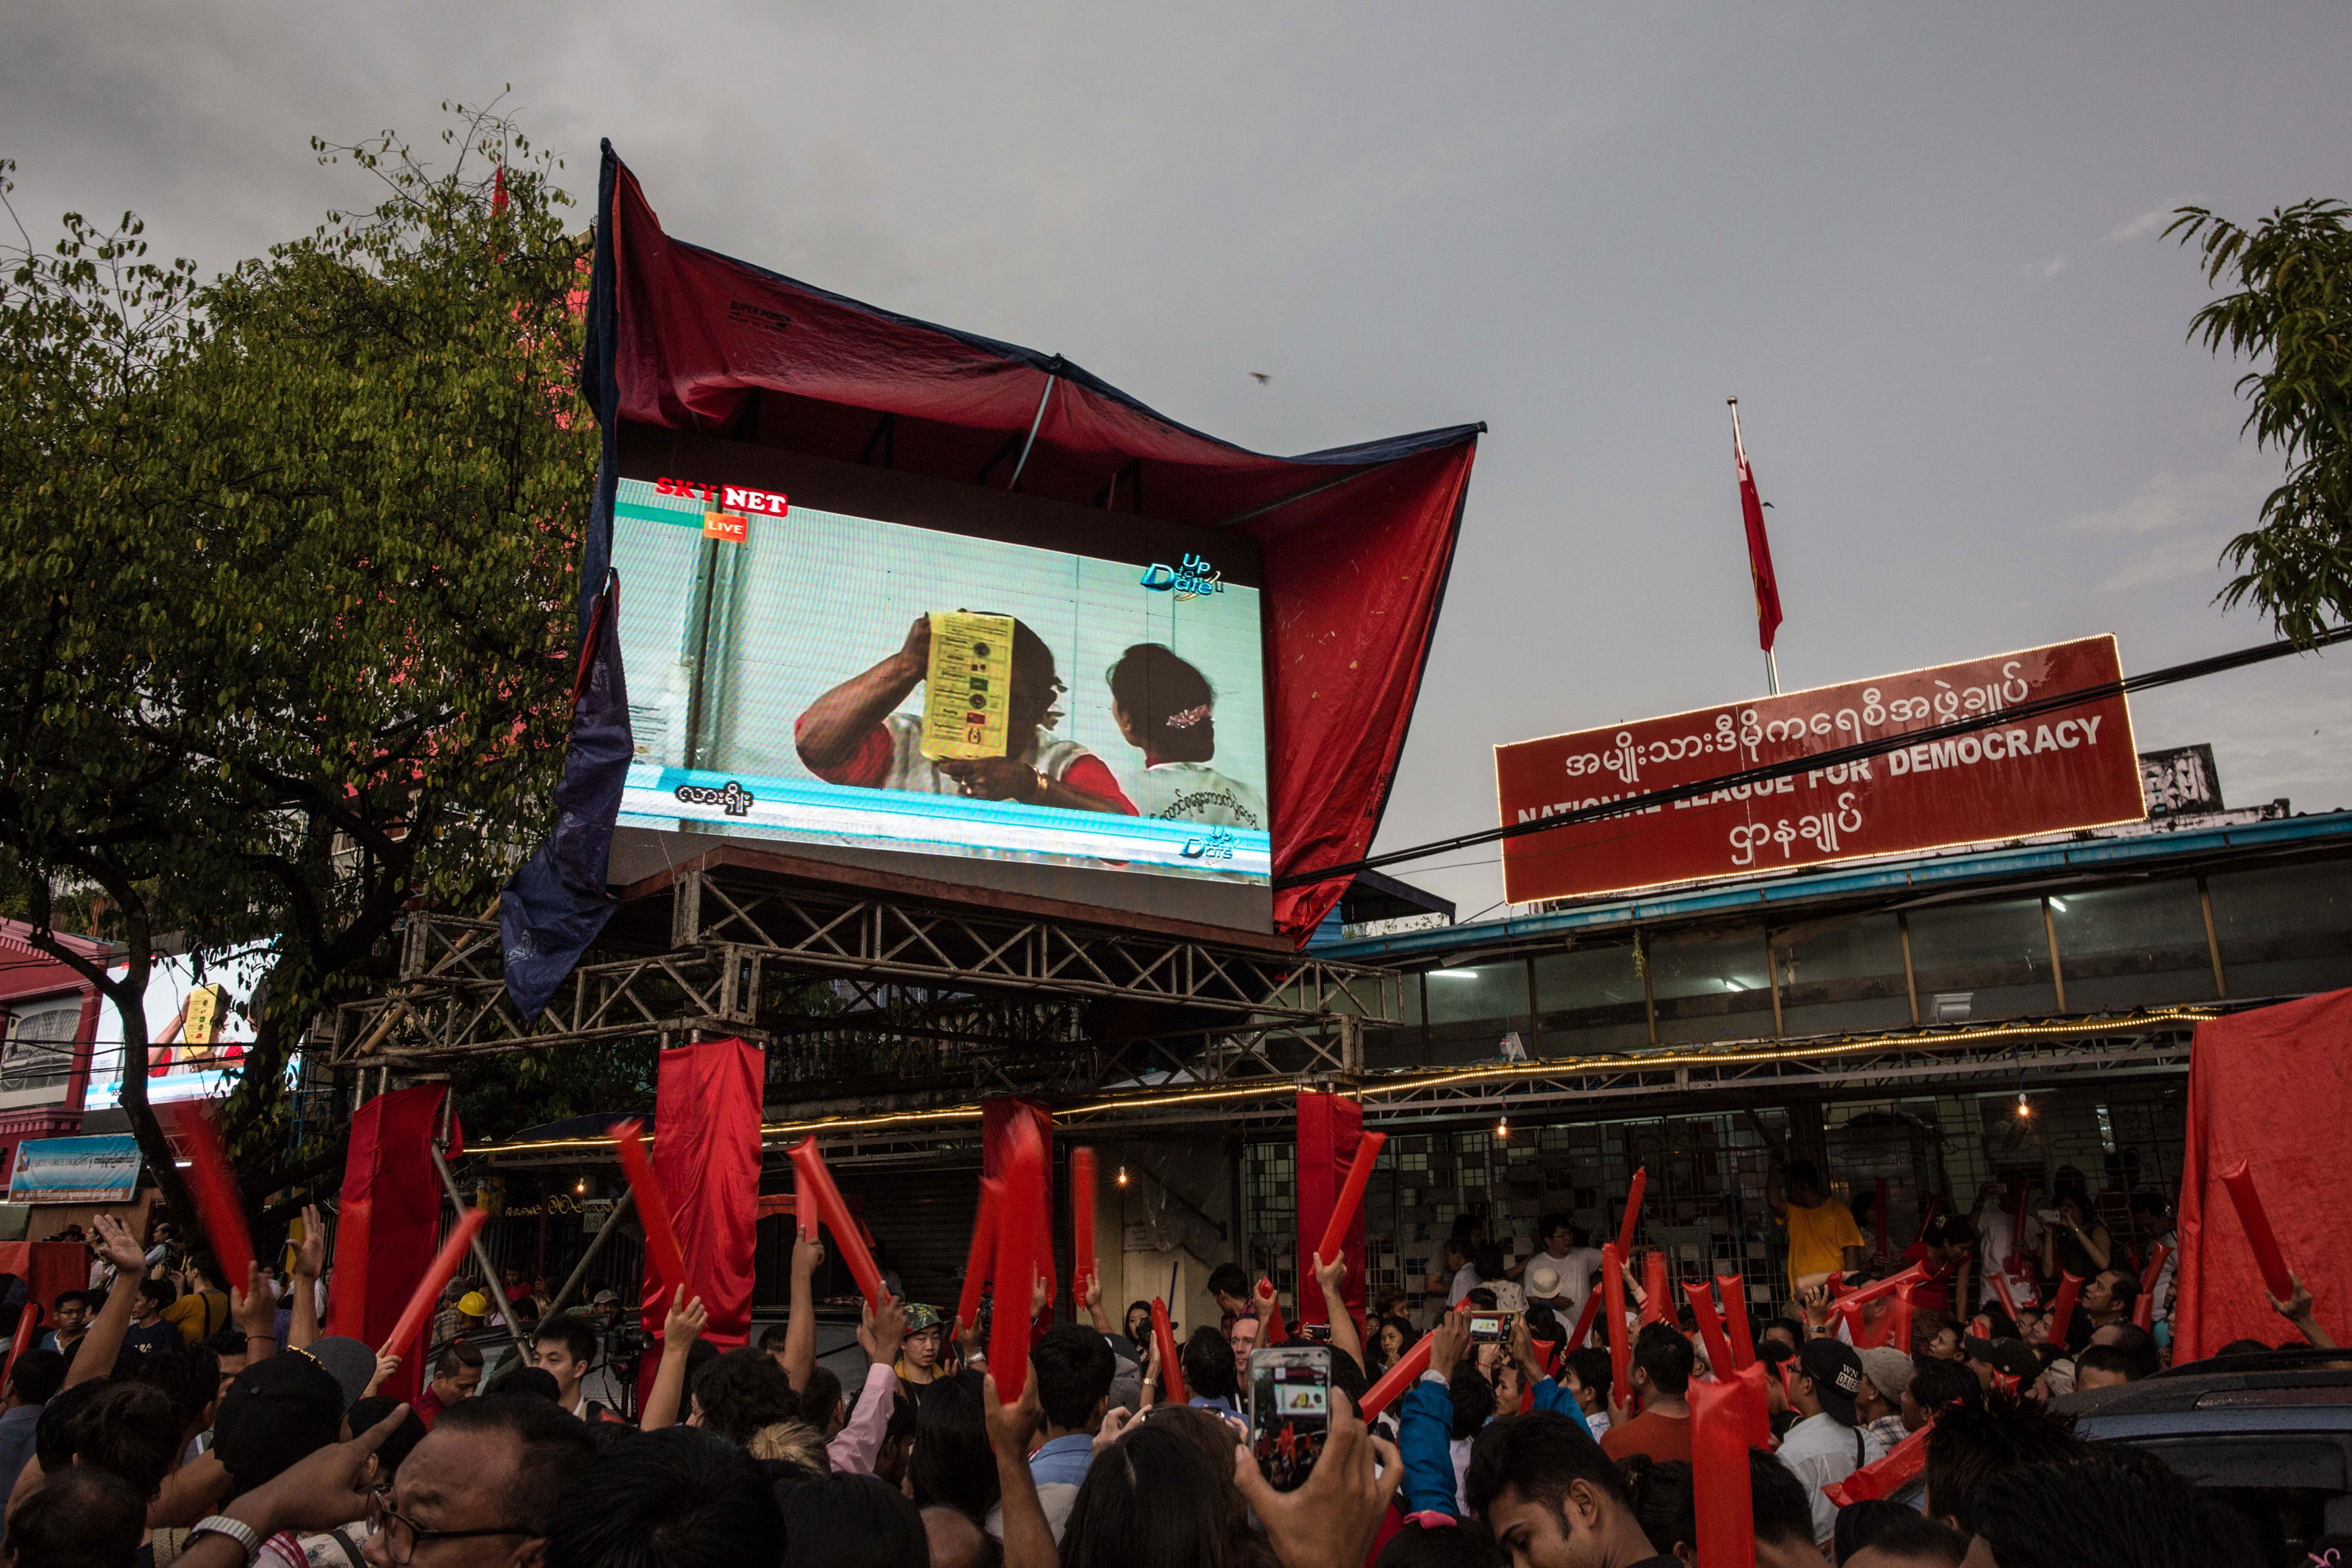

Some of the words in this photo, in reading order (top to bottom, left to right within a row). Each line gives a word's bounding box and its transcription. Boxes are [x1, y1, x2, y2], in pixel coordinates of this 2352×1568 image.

[708, 520, 743, 535] LIVE
[1182, 553, 1210, 575] Up
[1141, 563, 1214, 595] Date
[1808, 757, 1873, 789] FOR
[1889, 716, 2102, 776] DEMOCRACY
